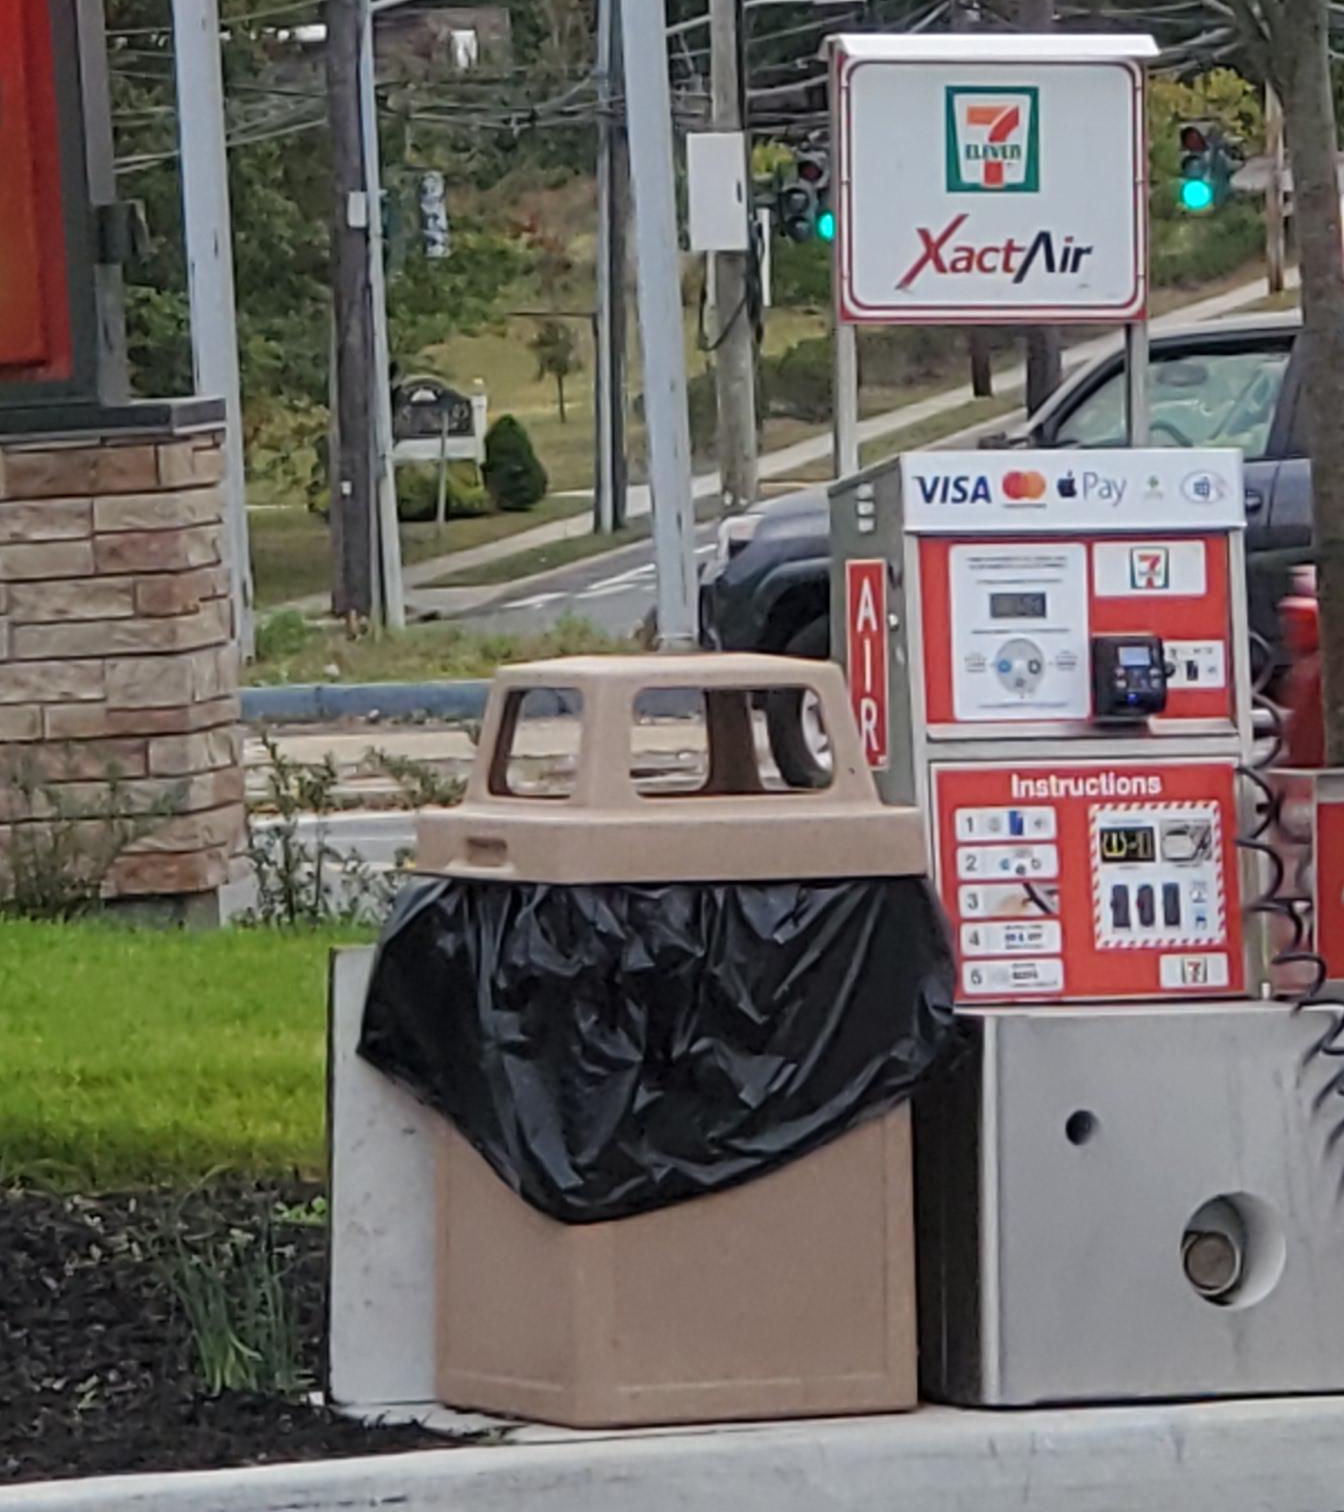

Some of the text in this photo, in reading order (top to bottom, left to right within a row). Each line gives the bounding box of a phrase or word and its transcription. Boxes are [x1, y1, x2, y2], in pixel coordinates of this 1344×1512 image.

[895, 213, 1092, 290] XactAir
[912, 471, 1127, 507] VISA Pay
[1011, 773, 1162, 798] Instructions
[965, 816, 974, 833] 1
[965, 854, 977, 871] 2
[967, 892, 979, 911] 3
[968, 930, 980, 947] 4
